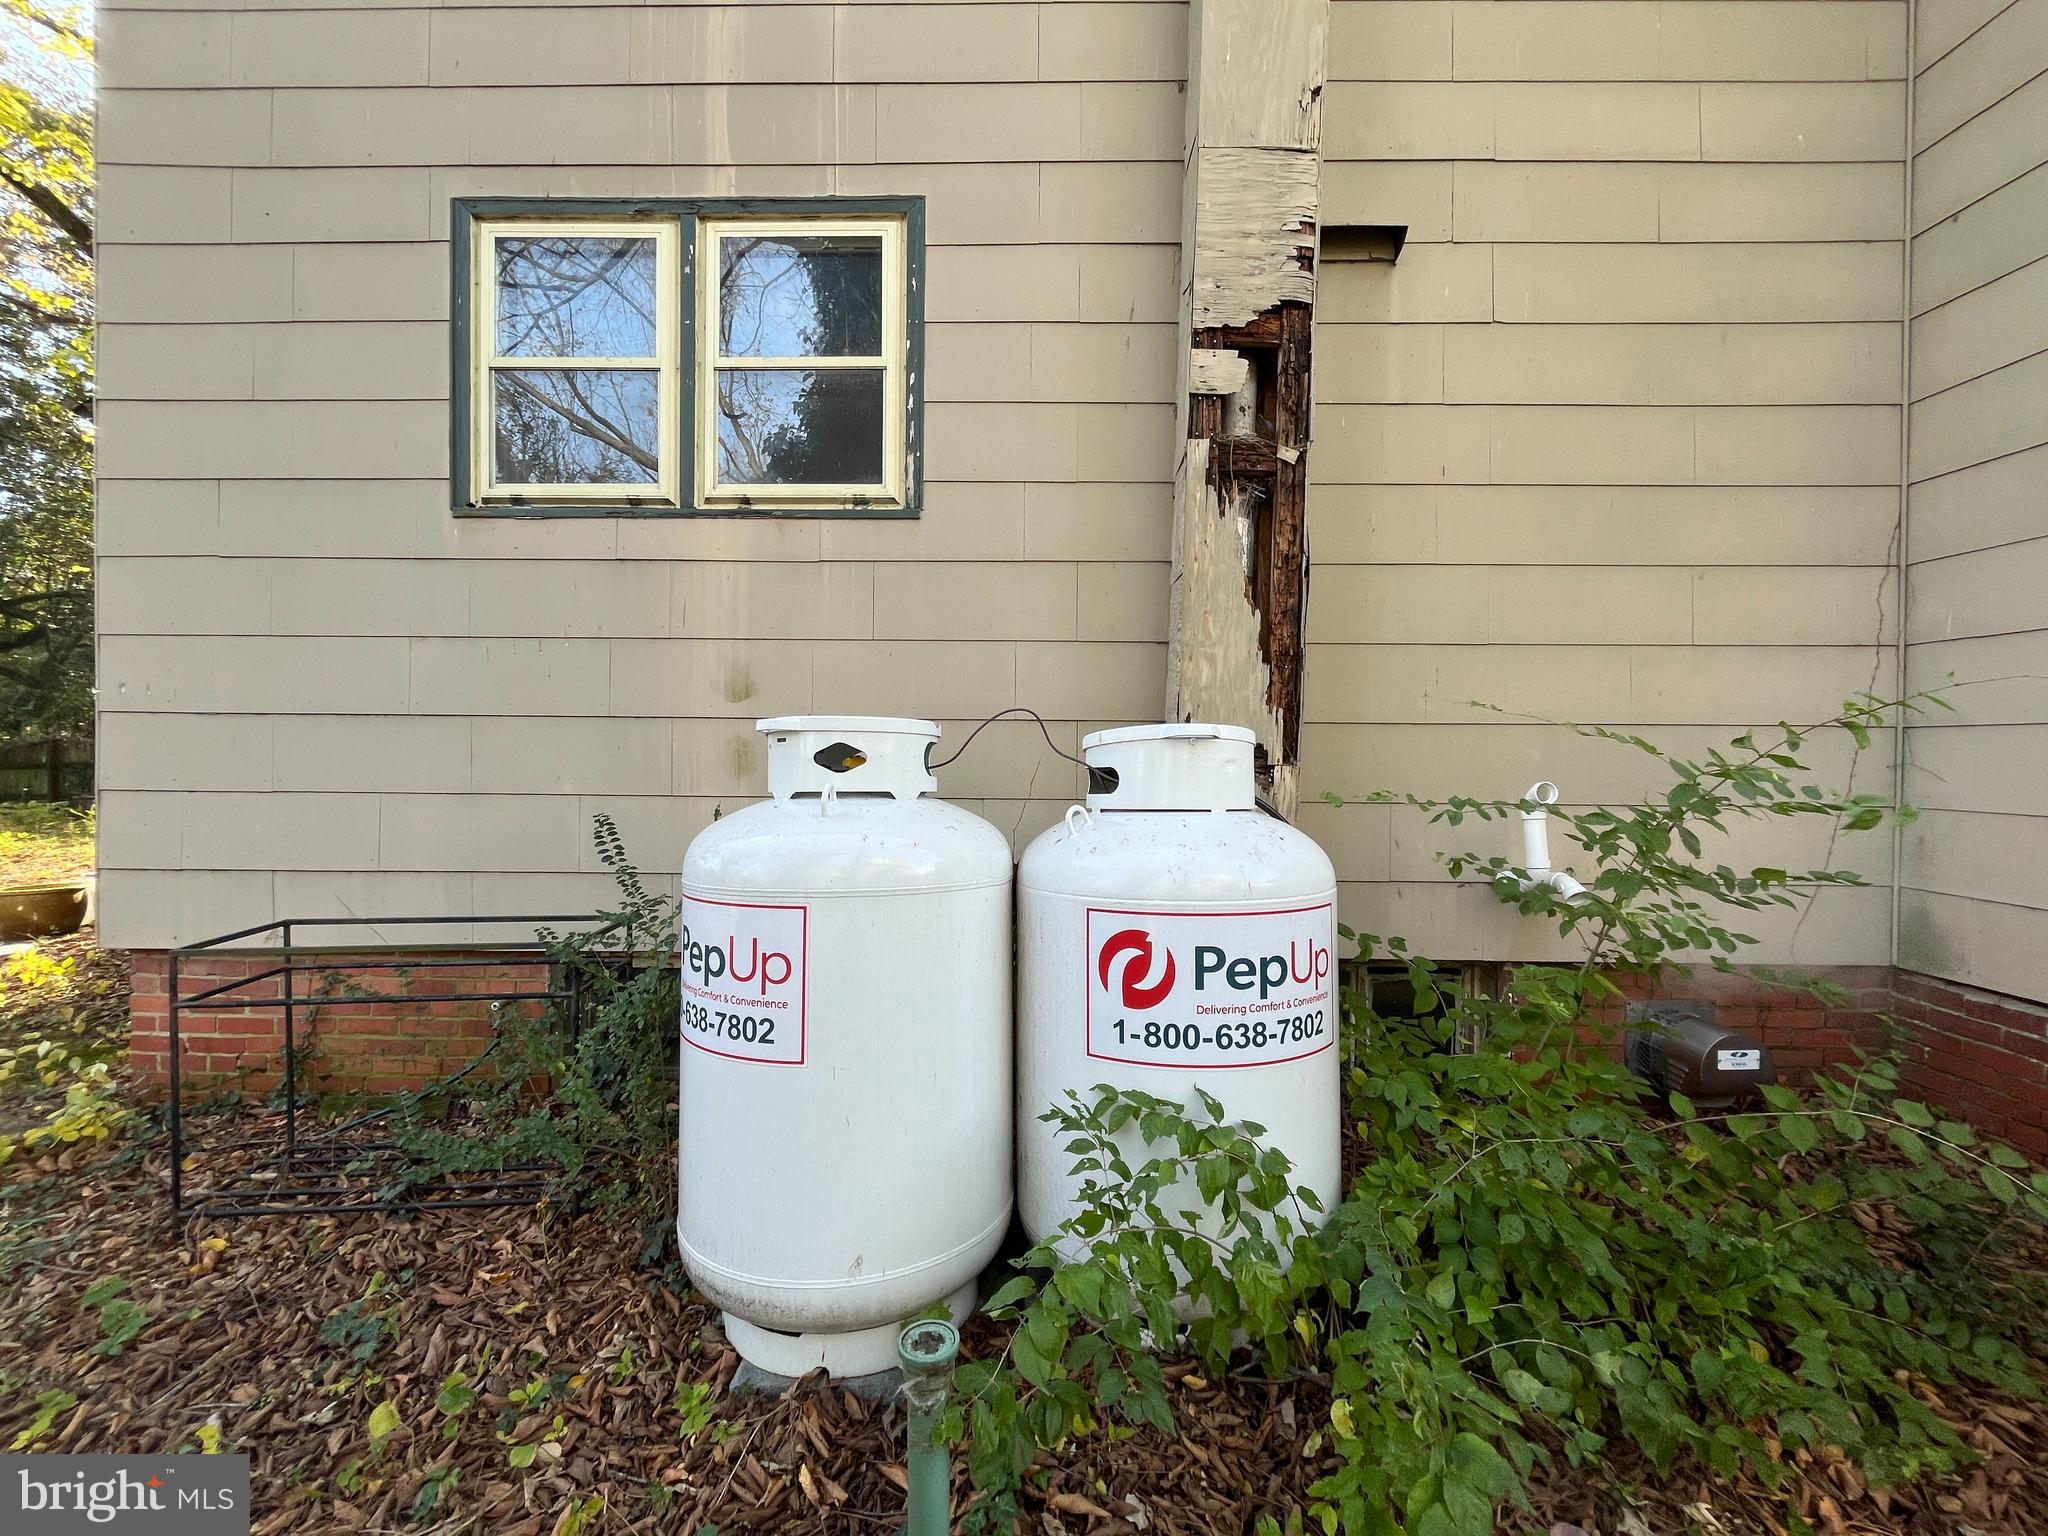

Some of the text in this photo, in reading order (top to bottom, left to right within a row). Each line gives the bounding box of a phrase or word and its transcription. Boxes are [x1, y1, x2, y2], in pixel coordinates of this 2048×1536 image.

[682, 924, 792, 996] PepUp
[1194, 938, 1329, 999] PepUp
[698, 987, 723, 1003] Comfort
[724, 994, 729, 1004] &
[730, 995, 789, 1010] Convenience
[1196, 991, 1329, 1016] Delivering Comfort & Convenience
[1112, 1010, 1325, 1050] 1-800-638-7802
